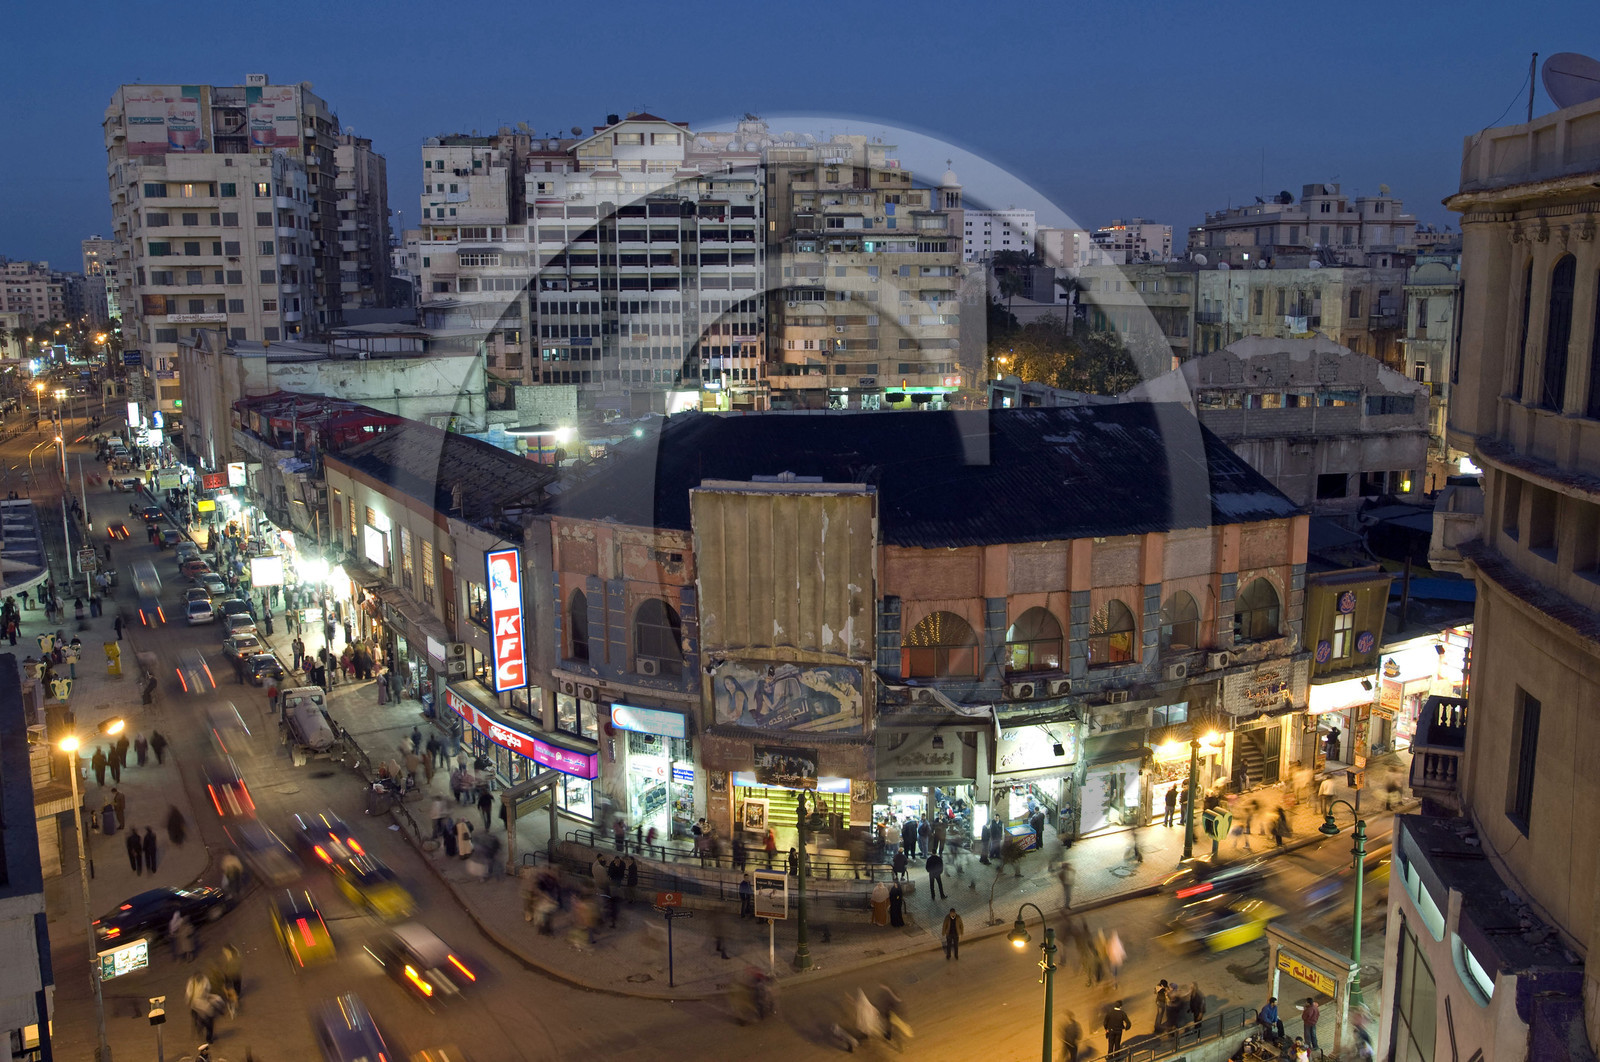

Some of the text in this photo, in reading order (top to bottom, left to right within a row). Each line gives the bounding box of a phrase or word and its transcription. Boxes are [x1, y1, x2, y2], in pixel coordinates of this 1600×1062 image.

[495, 614, 523, 681] KFC
[450, 693, 467, 717] KFC
[785, 699, 809, 723] الحب
